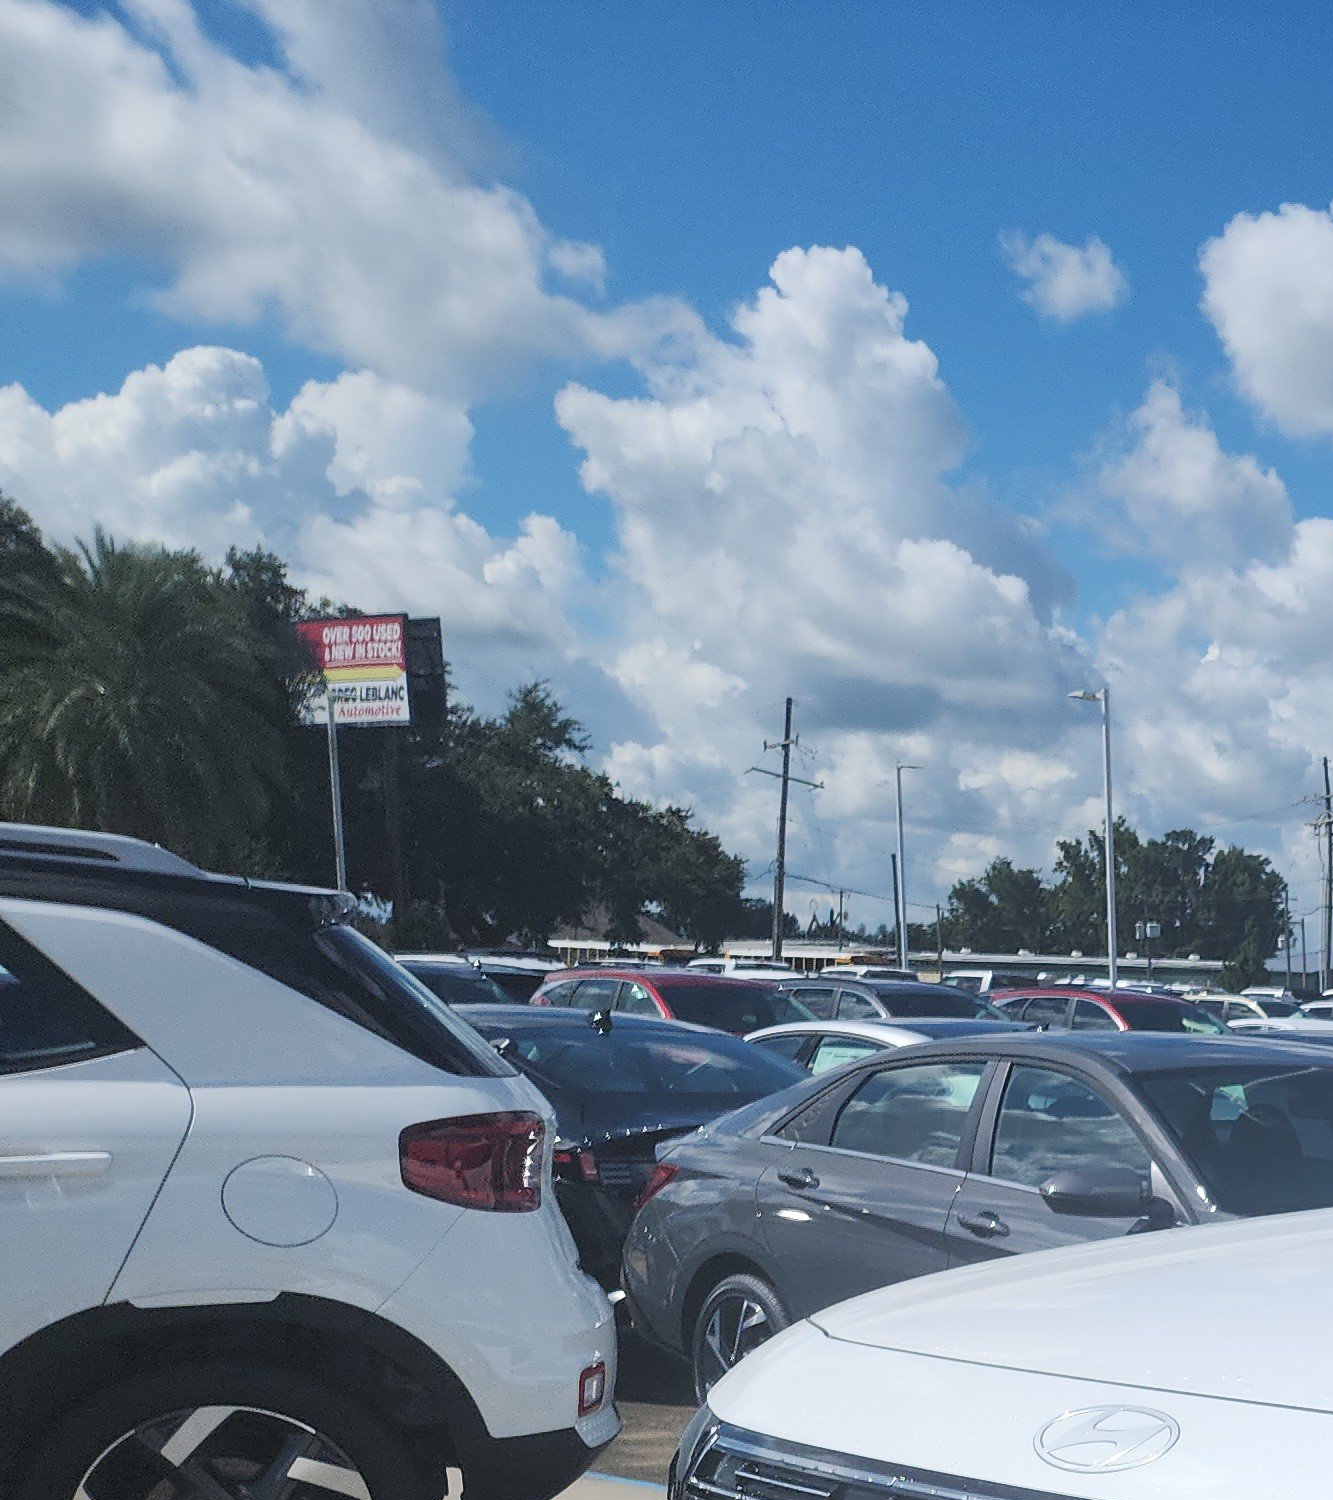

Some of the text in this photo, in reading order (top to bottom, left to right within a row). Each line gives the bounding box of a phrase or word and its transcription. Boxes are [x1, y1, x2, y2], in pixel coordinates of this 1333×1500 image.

[322, 626, 349, 643] OVER
[373, 623, 400, 641] USED
[331, 644, 354, 661] NEW
[355, 643, 366, 660] IN
[359, 685, 405, 702] LEBLANC
[338, 704, 401, 718] Automotive
